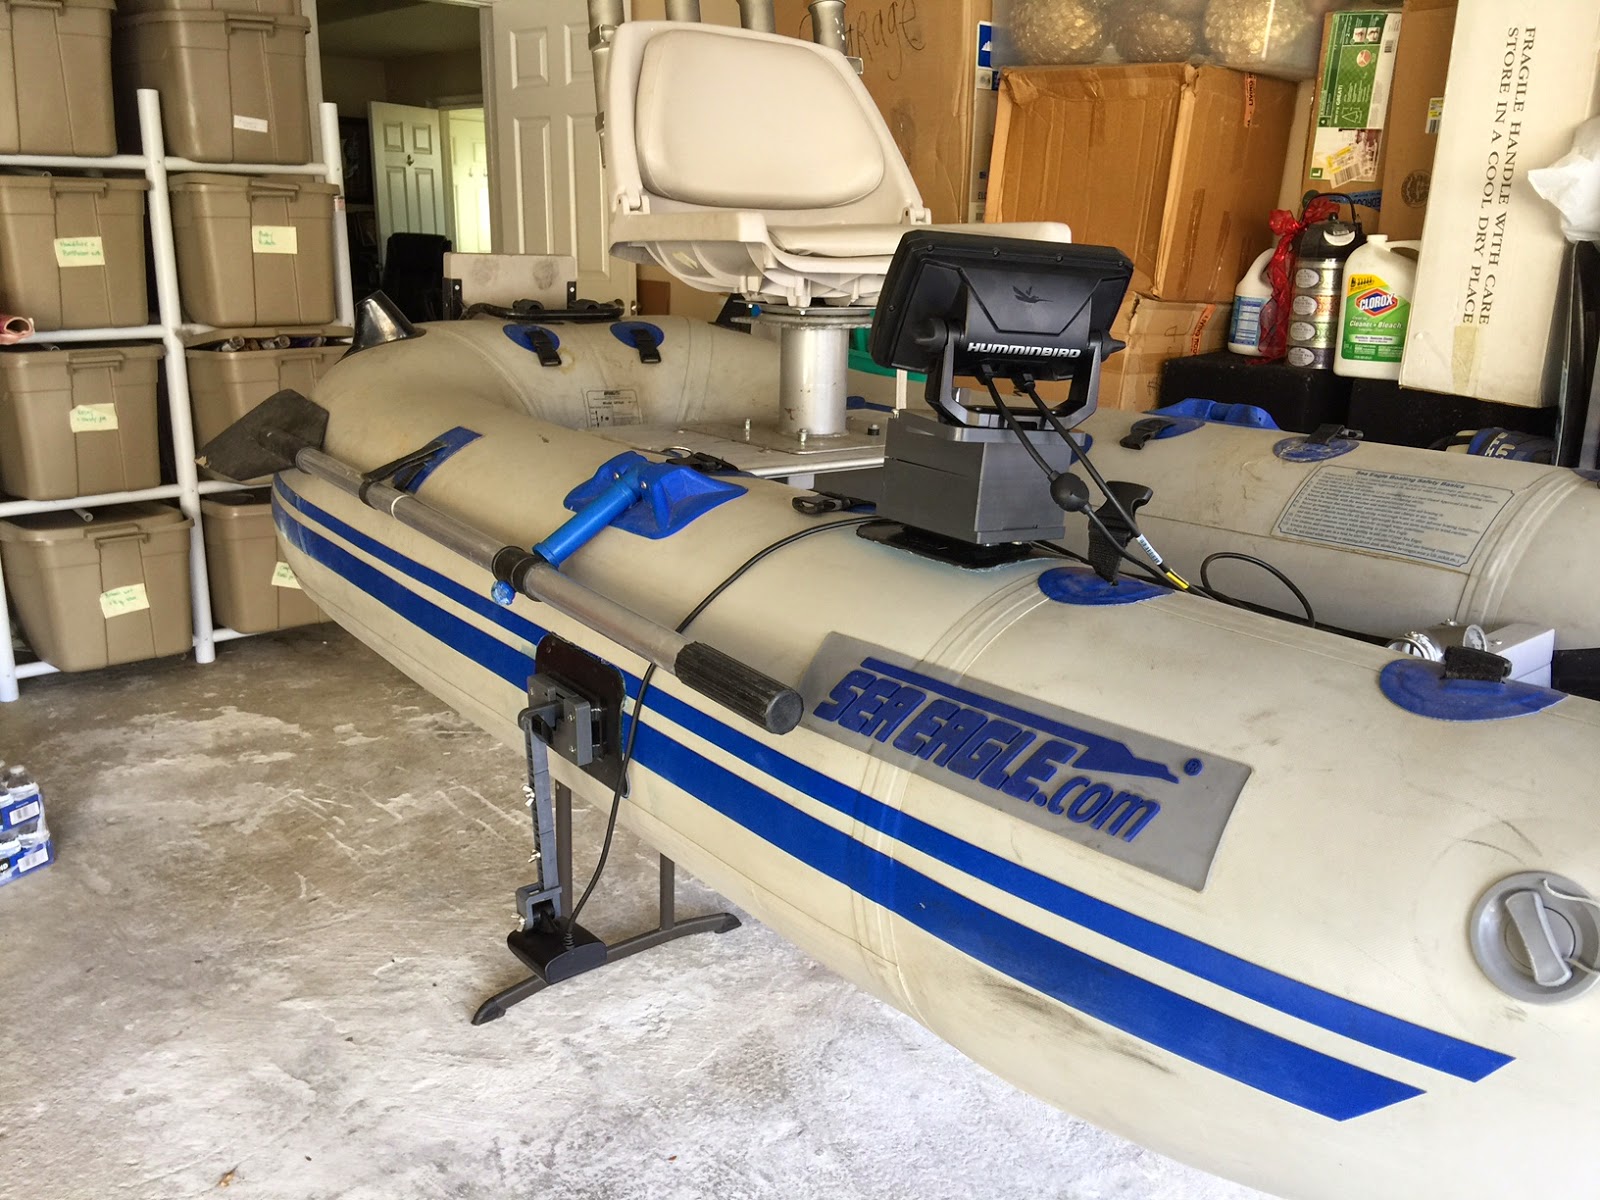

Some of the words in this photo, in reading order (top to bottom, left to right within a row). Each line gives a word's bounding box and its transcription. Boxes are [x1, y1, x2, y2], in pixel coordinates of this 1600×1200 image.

[1499, 27, 1519, 93] STORE
[1513, 26, 1536, 112] FRAGILE
[1491, 130, 1502, 143] A
[1494, 101, 1508, 124] IN
[1480, 150, 1499, 209] COOL
[1499, 121, 1522, 205] HANDLE
[1474, 216, 1489, 257] DRY
[1488, 211, 1507, 266] WITH
[1359, 293, 1394, 310] CLOROX
[1462, 265, 1481, 324] PLACE
[1478, 273, 1496, 325] CARE
[967, 342, 1081, 358] HUMMINBIRD
[1389, 474, 1416, 483] Boating
[1417, 478, 1438, 486] Safety
[1440, 481, 1465, 489] Basics
[812, 670, 926, 743] SEA
